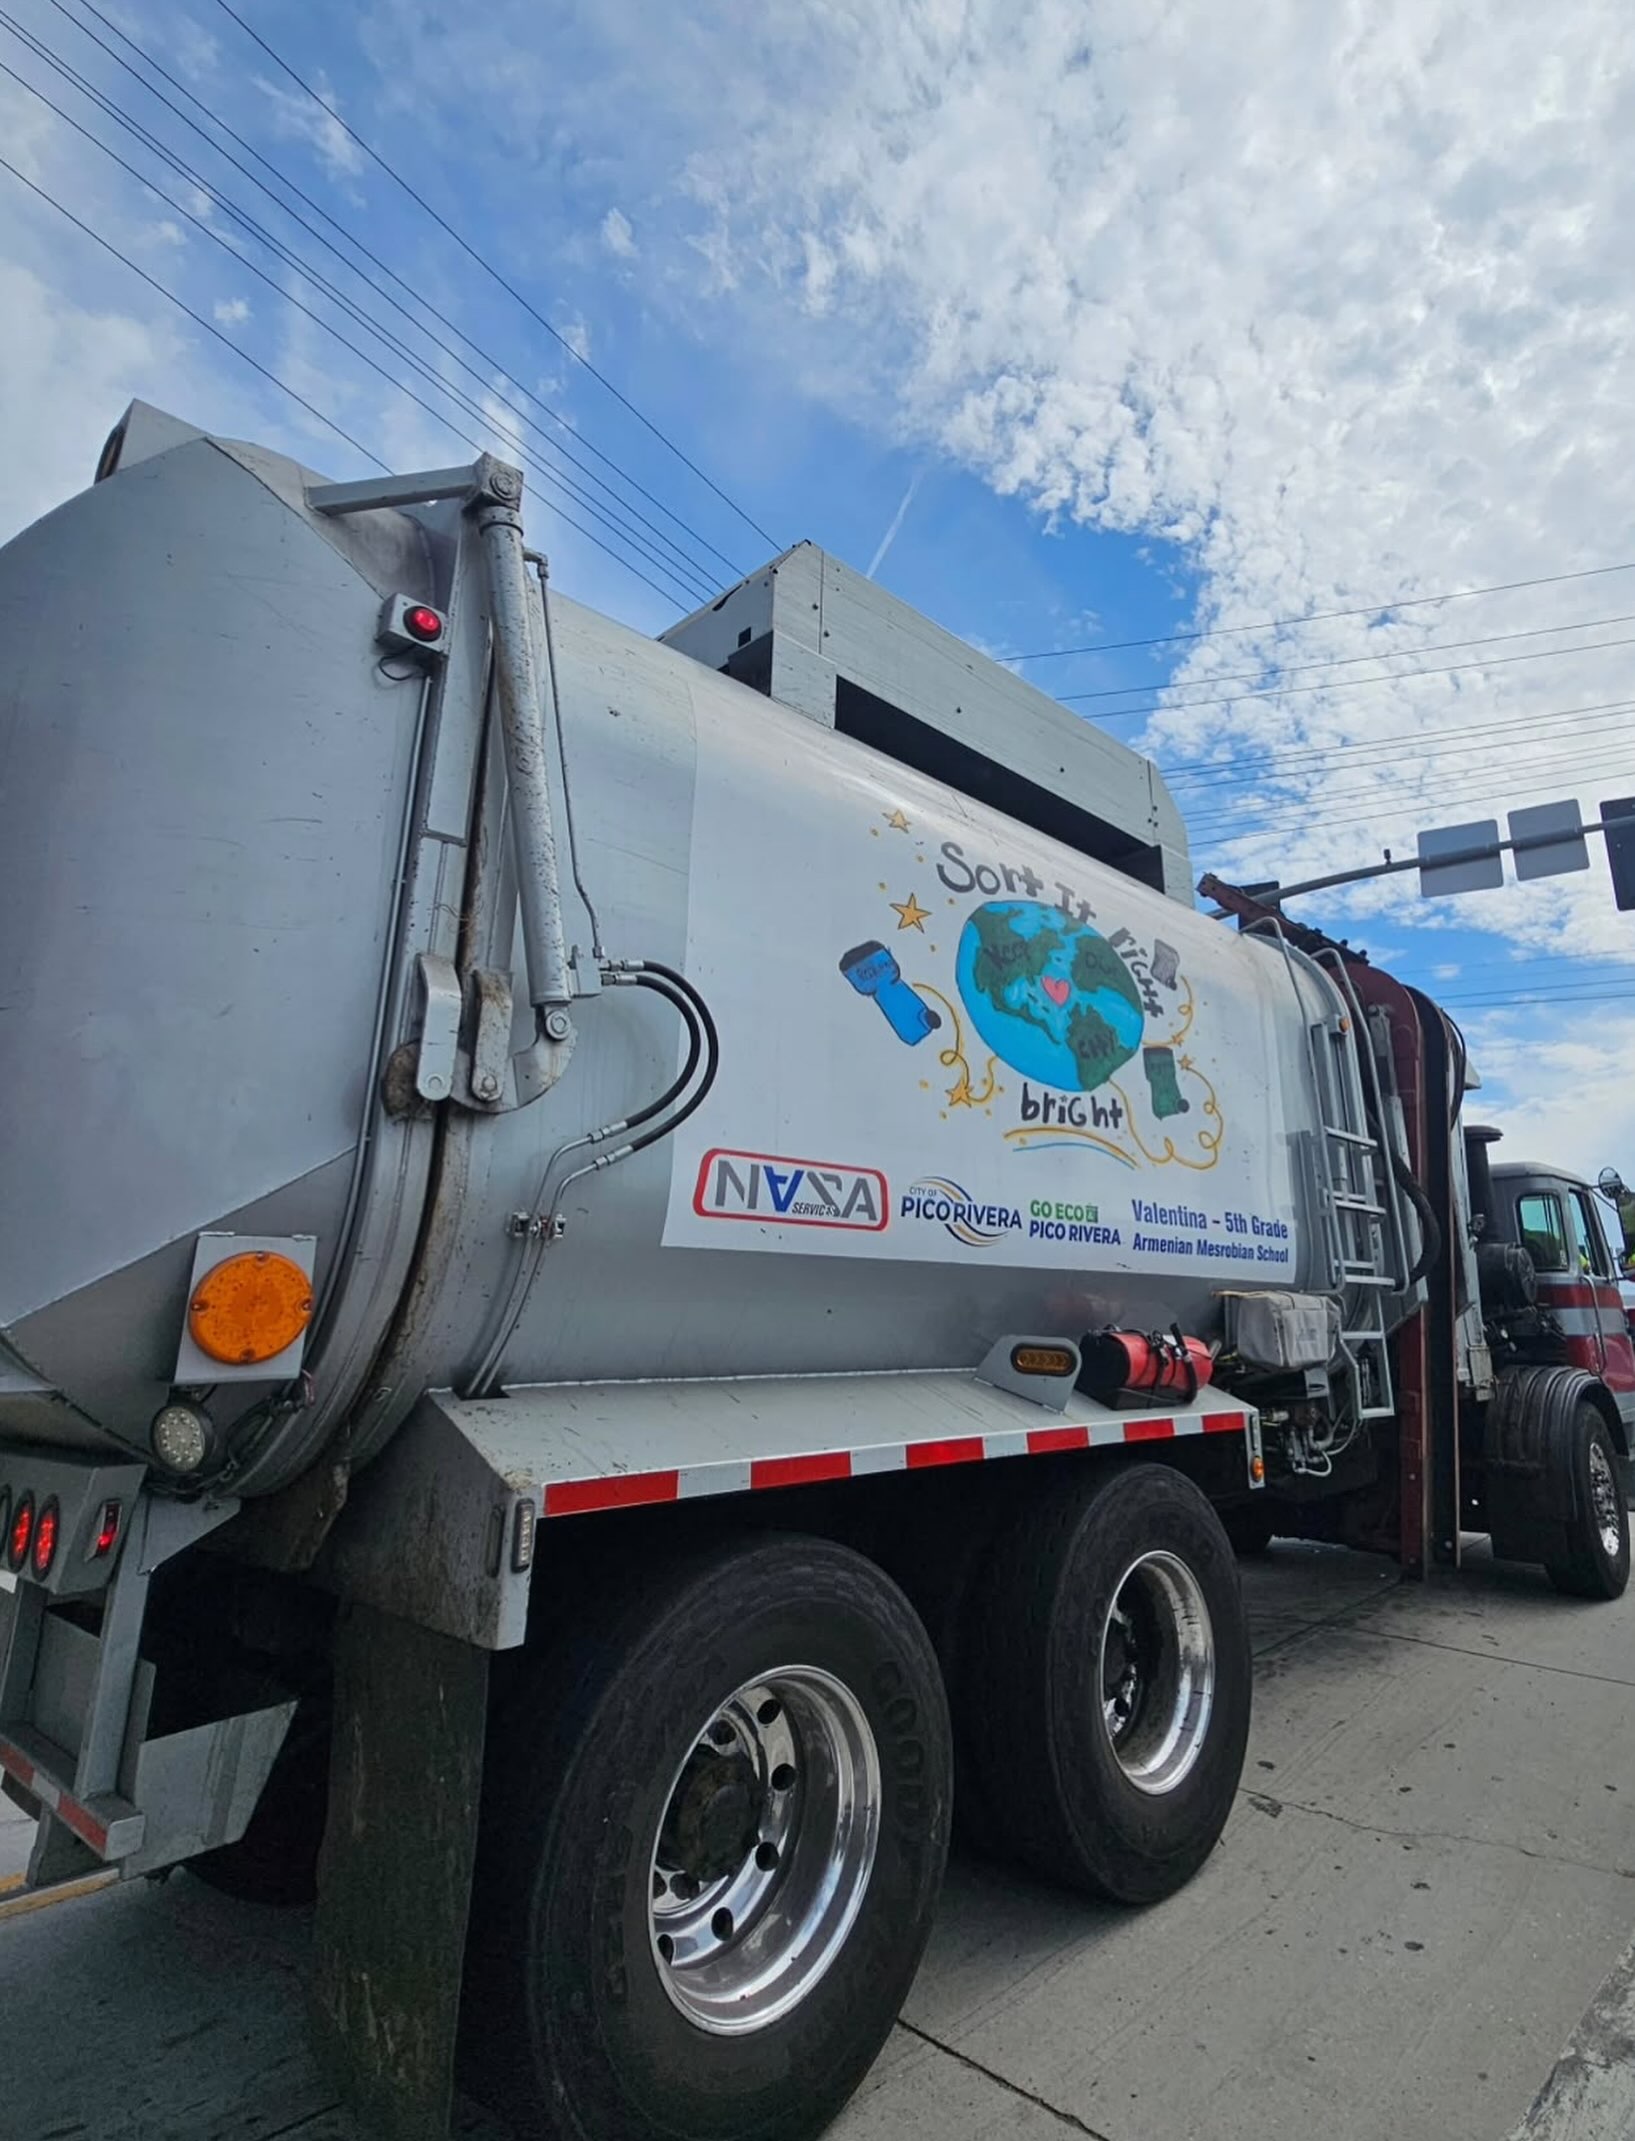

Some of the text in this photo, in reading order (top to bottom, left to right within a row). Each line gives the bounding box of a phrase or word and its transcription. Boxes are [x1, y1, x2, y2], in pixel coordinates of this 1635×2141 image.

[936, 841, 1044, 897] Sort
[909, 1185, 937, 1198] CITY OF
[1030, 1199, 1085, 1223] GO ECO
[1131, 1199, 1208, 1230] Valentina
[1224, 1211, 1248, 1234] 5th
[1251, 1215, 1289, 1240] Grade
[1029, 1220, 1121, 1246] PICO RIVERA
[1132, 1232, 1289, 1263] Armenian Mesrobian School
